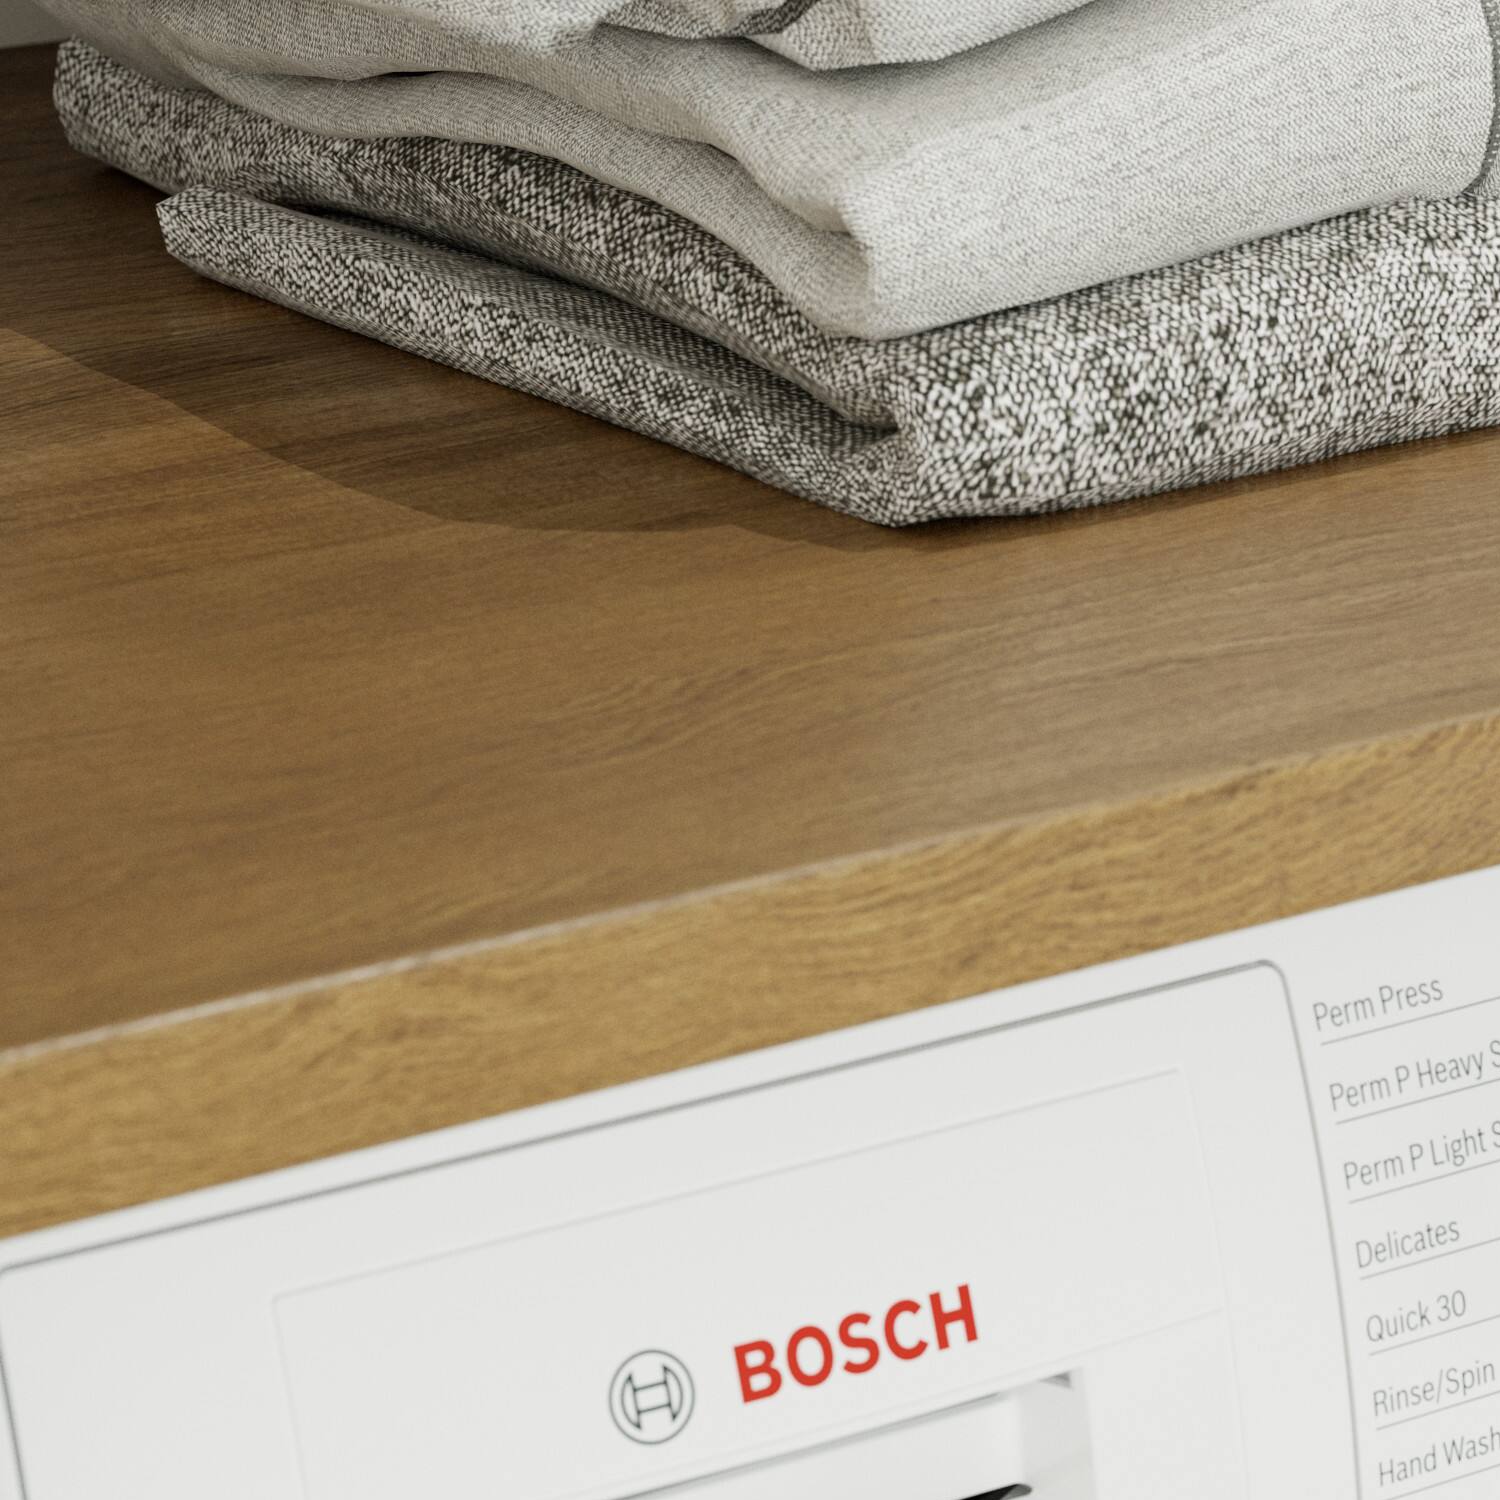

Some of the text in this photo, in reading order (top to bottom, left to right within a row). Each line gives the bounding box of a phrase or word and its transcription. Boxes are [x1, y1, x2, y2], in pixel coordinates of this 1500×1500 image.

[1312, 976, 1444, 1031] Perm Press
[1328, 1072, 1391, 1111] Perm
[1395, 1065, 1410, 1094] P
[1416, 1048, 1484, 1089] Heavy
[1343, 1151, 1405, 1190] Perm
[1409, 1143, 1424, 1172] P
[1430, 1126, 1487, 1167] Light
[1355, 1220, 1460, 1269] Delicates
[733, 1284, 978, 1403] BOSCH
[1366, 1290, 1467, 1343] Quick 30
[1373, 1359, 1496, 1416] Rinse/Spin
[1378, 1447, 1438, 1486] Hand
